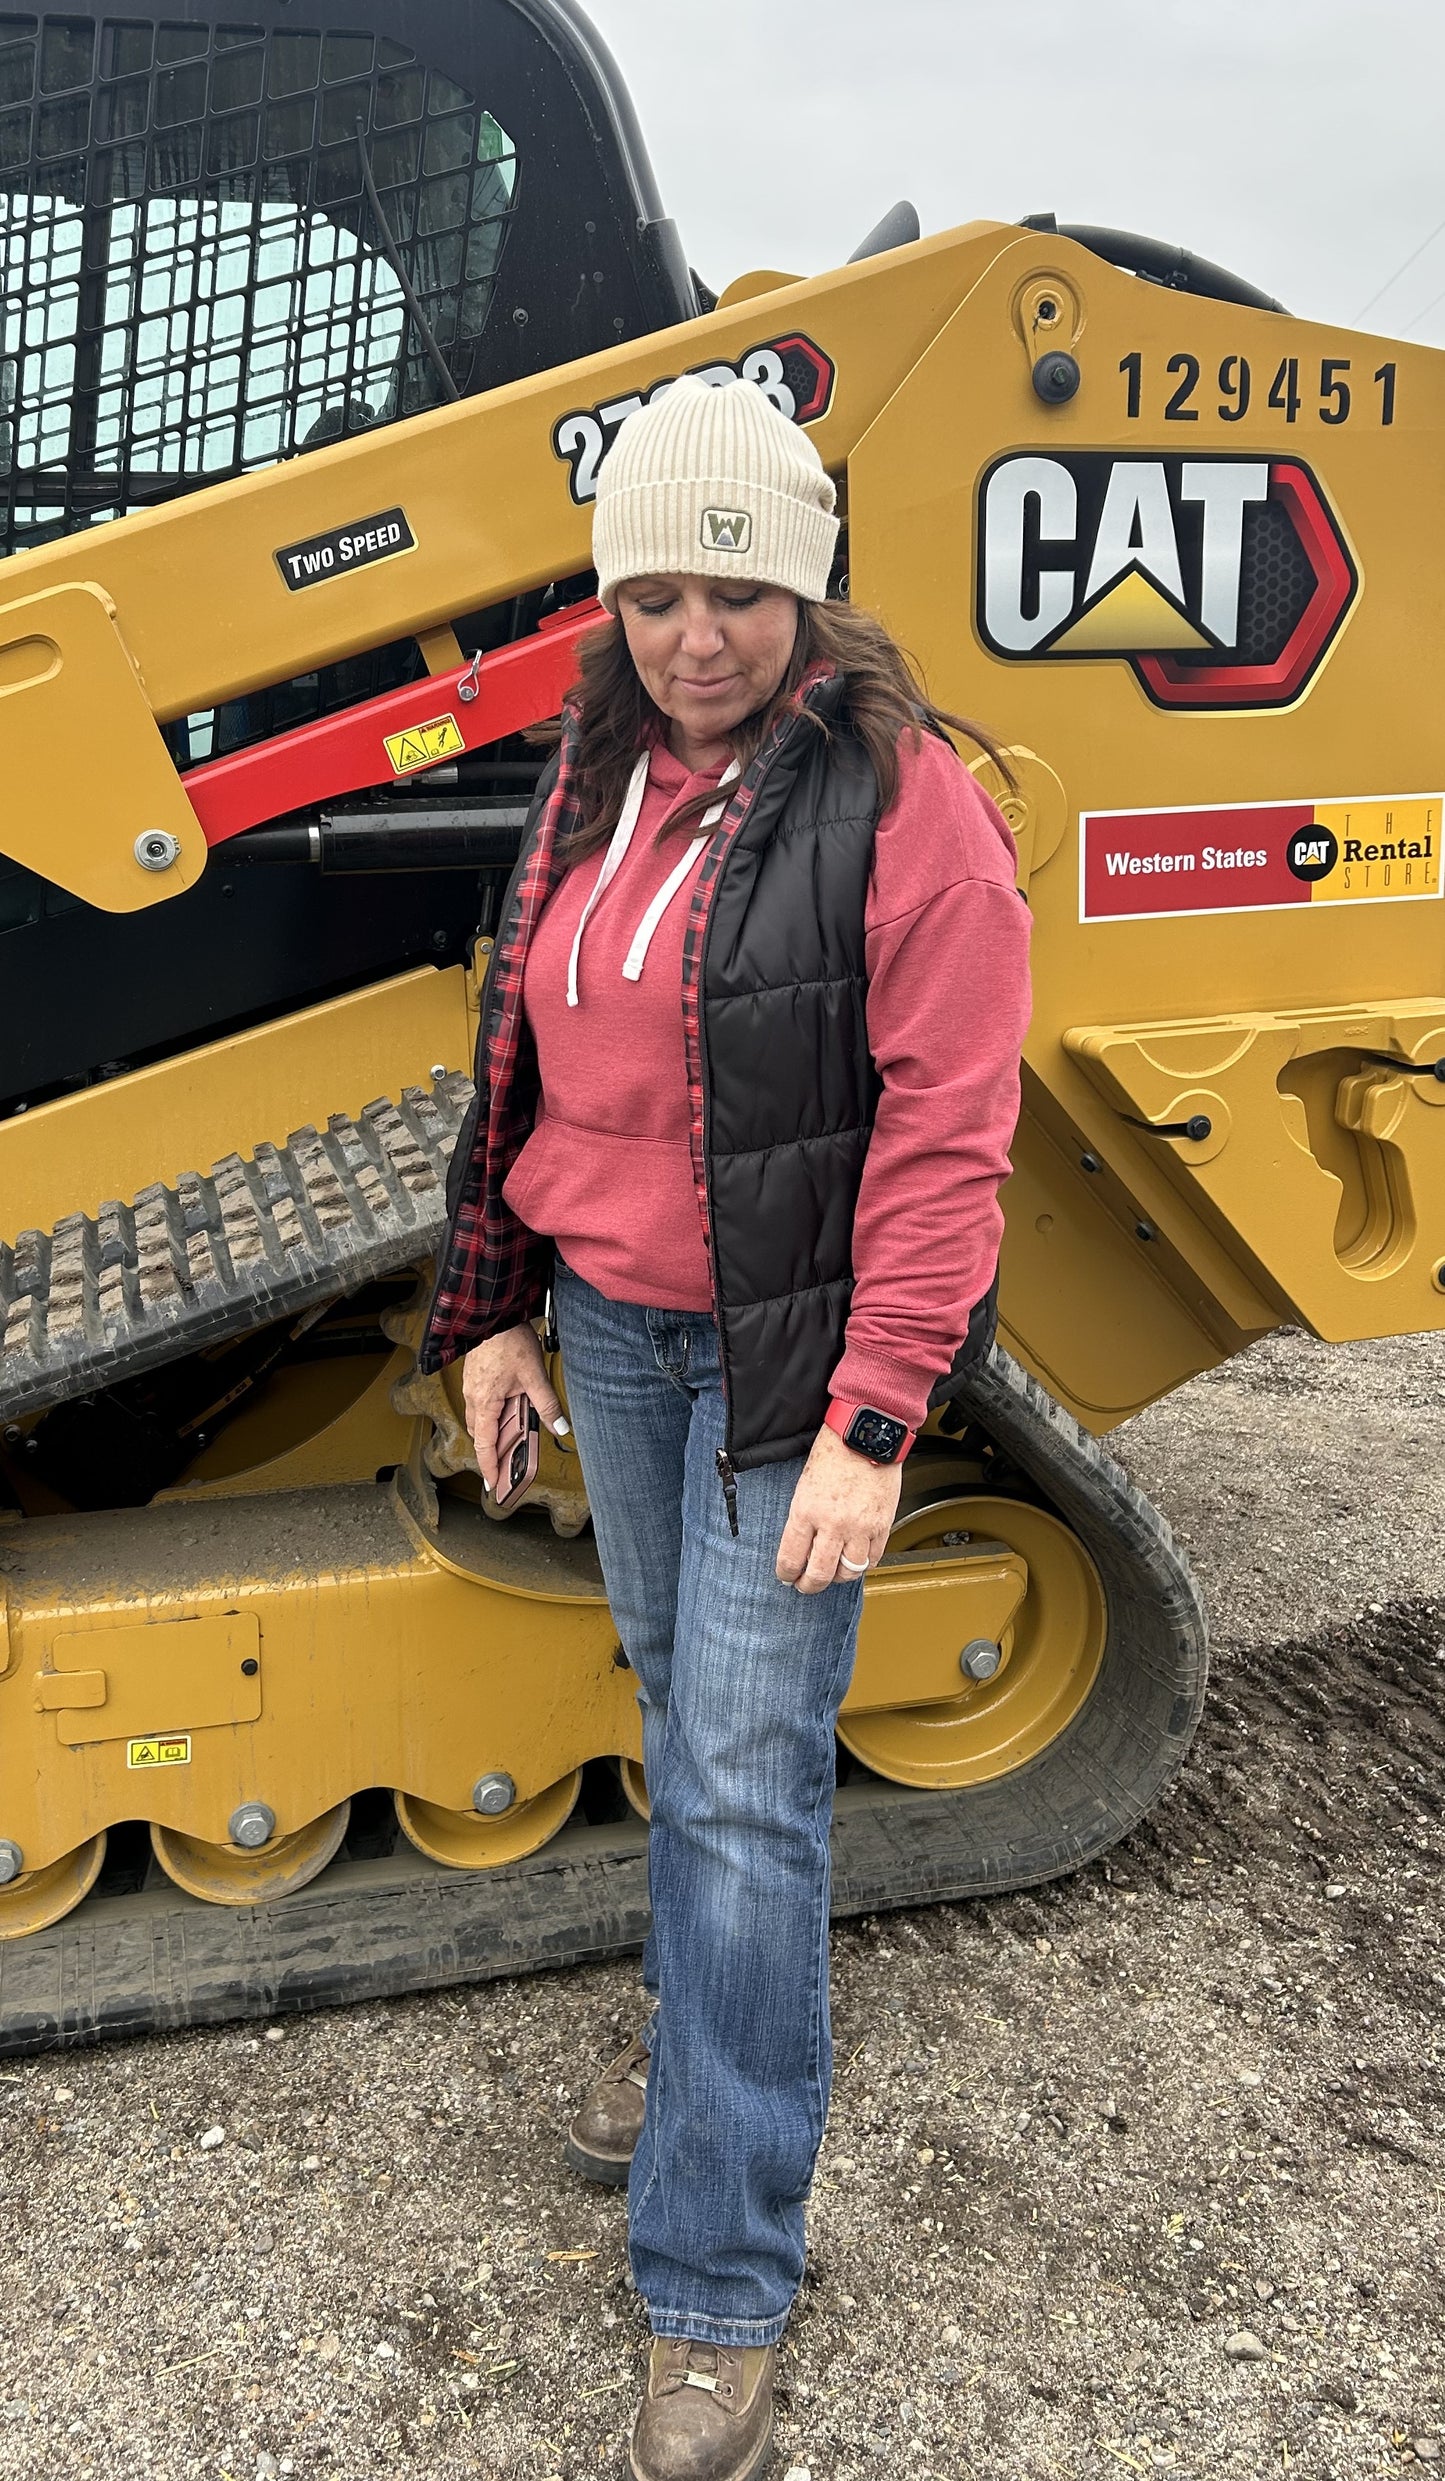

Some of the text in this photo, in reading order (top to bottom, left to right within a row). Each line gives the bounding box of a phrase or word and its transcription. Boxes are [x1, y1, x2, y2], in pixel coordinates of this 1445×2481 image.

[1119, 352, 1397, 426] 129451
[707, 512, 746, 547] W
[985, 457, 1269, 652] CAT
[1345, 809, 1433, 837] THE
[1105, 845, 1268, 877] Western States
[1294, 840, 1330, 867] CAT
[1343, 835, 1433, 863] Rental
[1345, 862, 1431, 889] STORE
